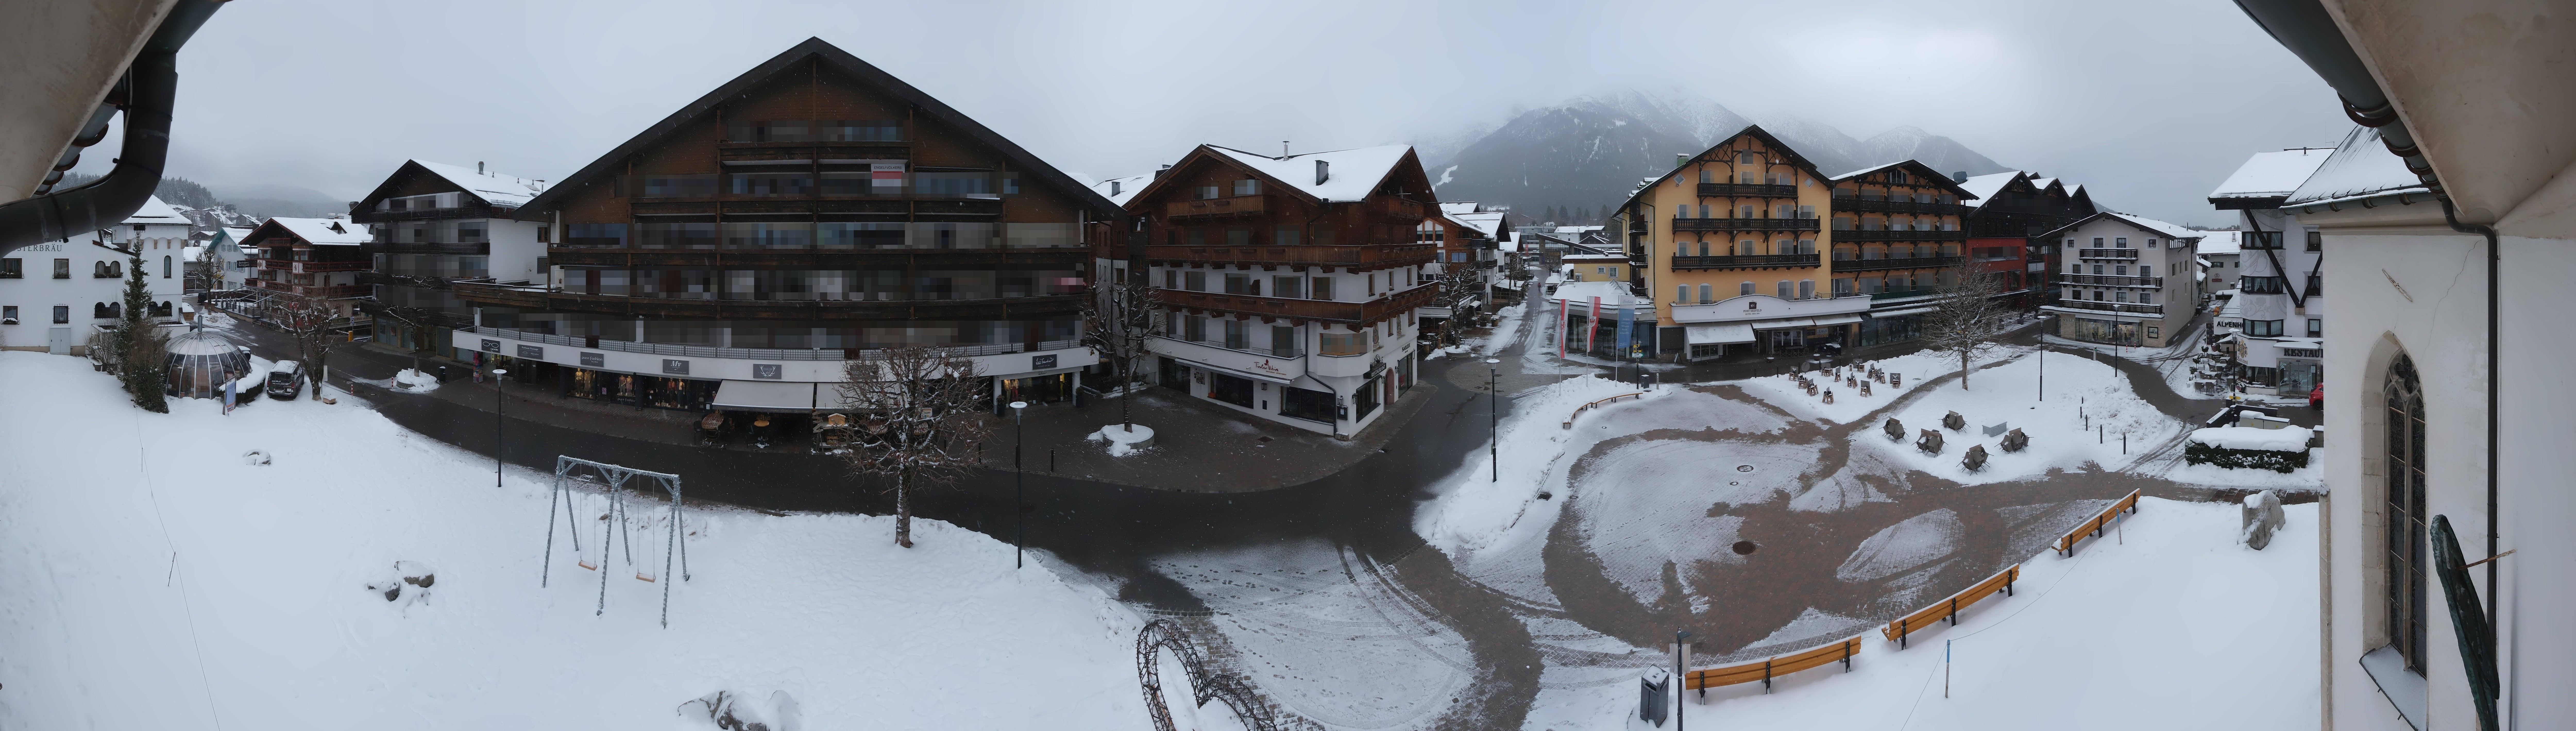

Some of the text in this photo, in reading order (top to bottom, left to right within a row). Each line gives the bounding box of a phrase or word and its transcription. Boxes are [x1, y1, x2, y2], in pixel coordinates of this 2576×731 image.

[1402, 343, 1410, 352] SAILER
[670, 361, 681, 370] My
[1371, 364, 1385, 377] RESTAURANT
